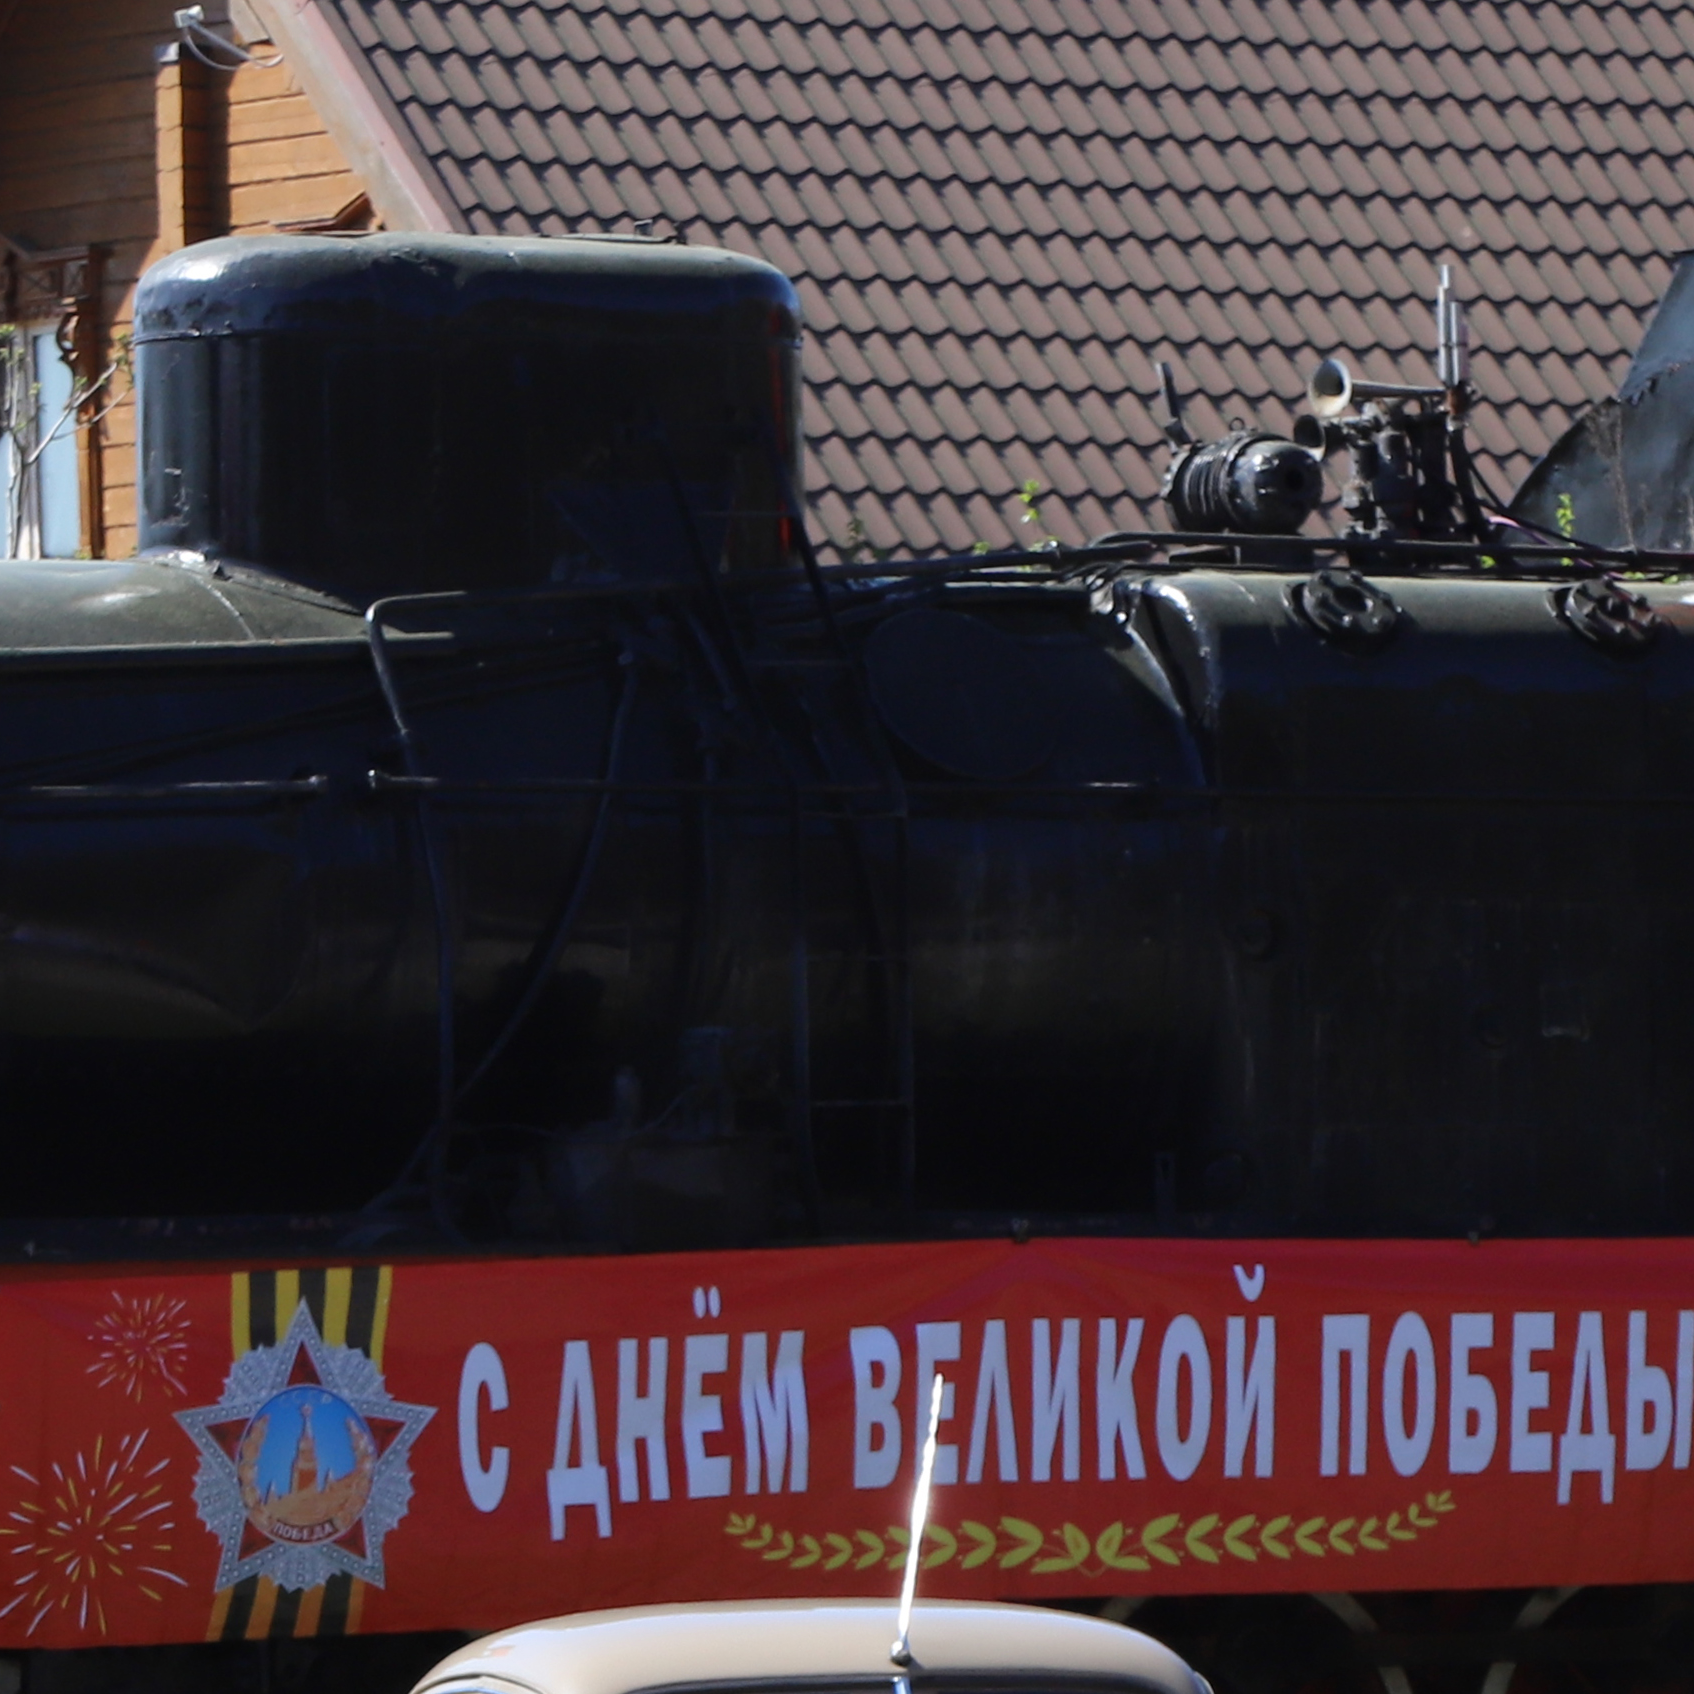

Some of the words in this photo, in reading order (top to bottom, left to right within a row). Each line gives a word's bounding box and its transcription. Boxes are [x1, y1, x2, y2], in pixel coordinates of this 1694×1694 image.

[458, 1341, 509, 1513] С
[546, 1286, 809, 1542] ДНЁМ
[850, 1263, 1276, 1489] ВЕЛИКОЙ
[273, 1520, 334, 1541] ПОБЕДА
